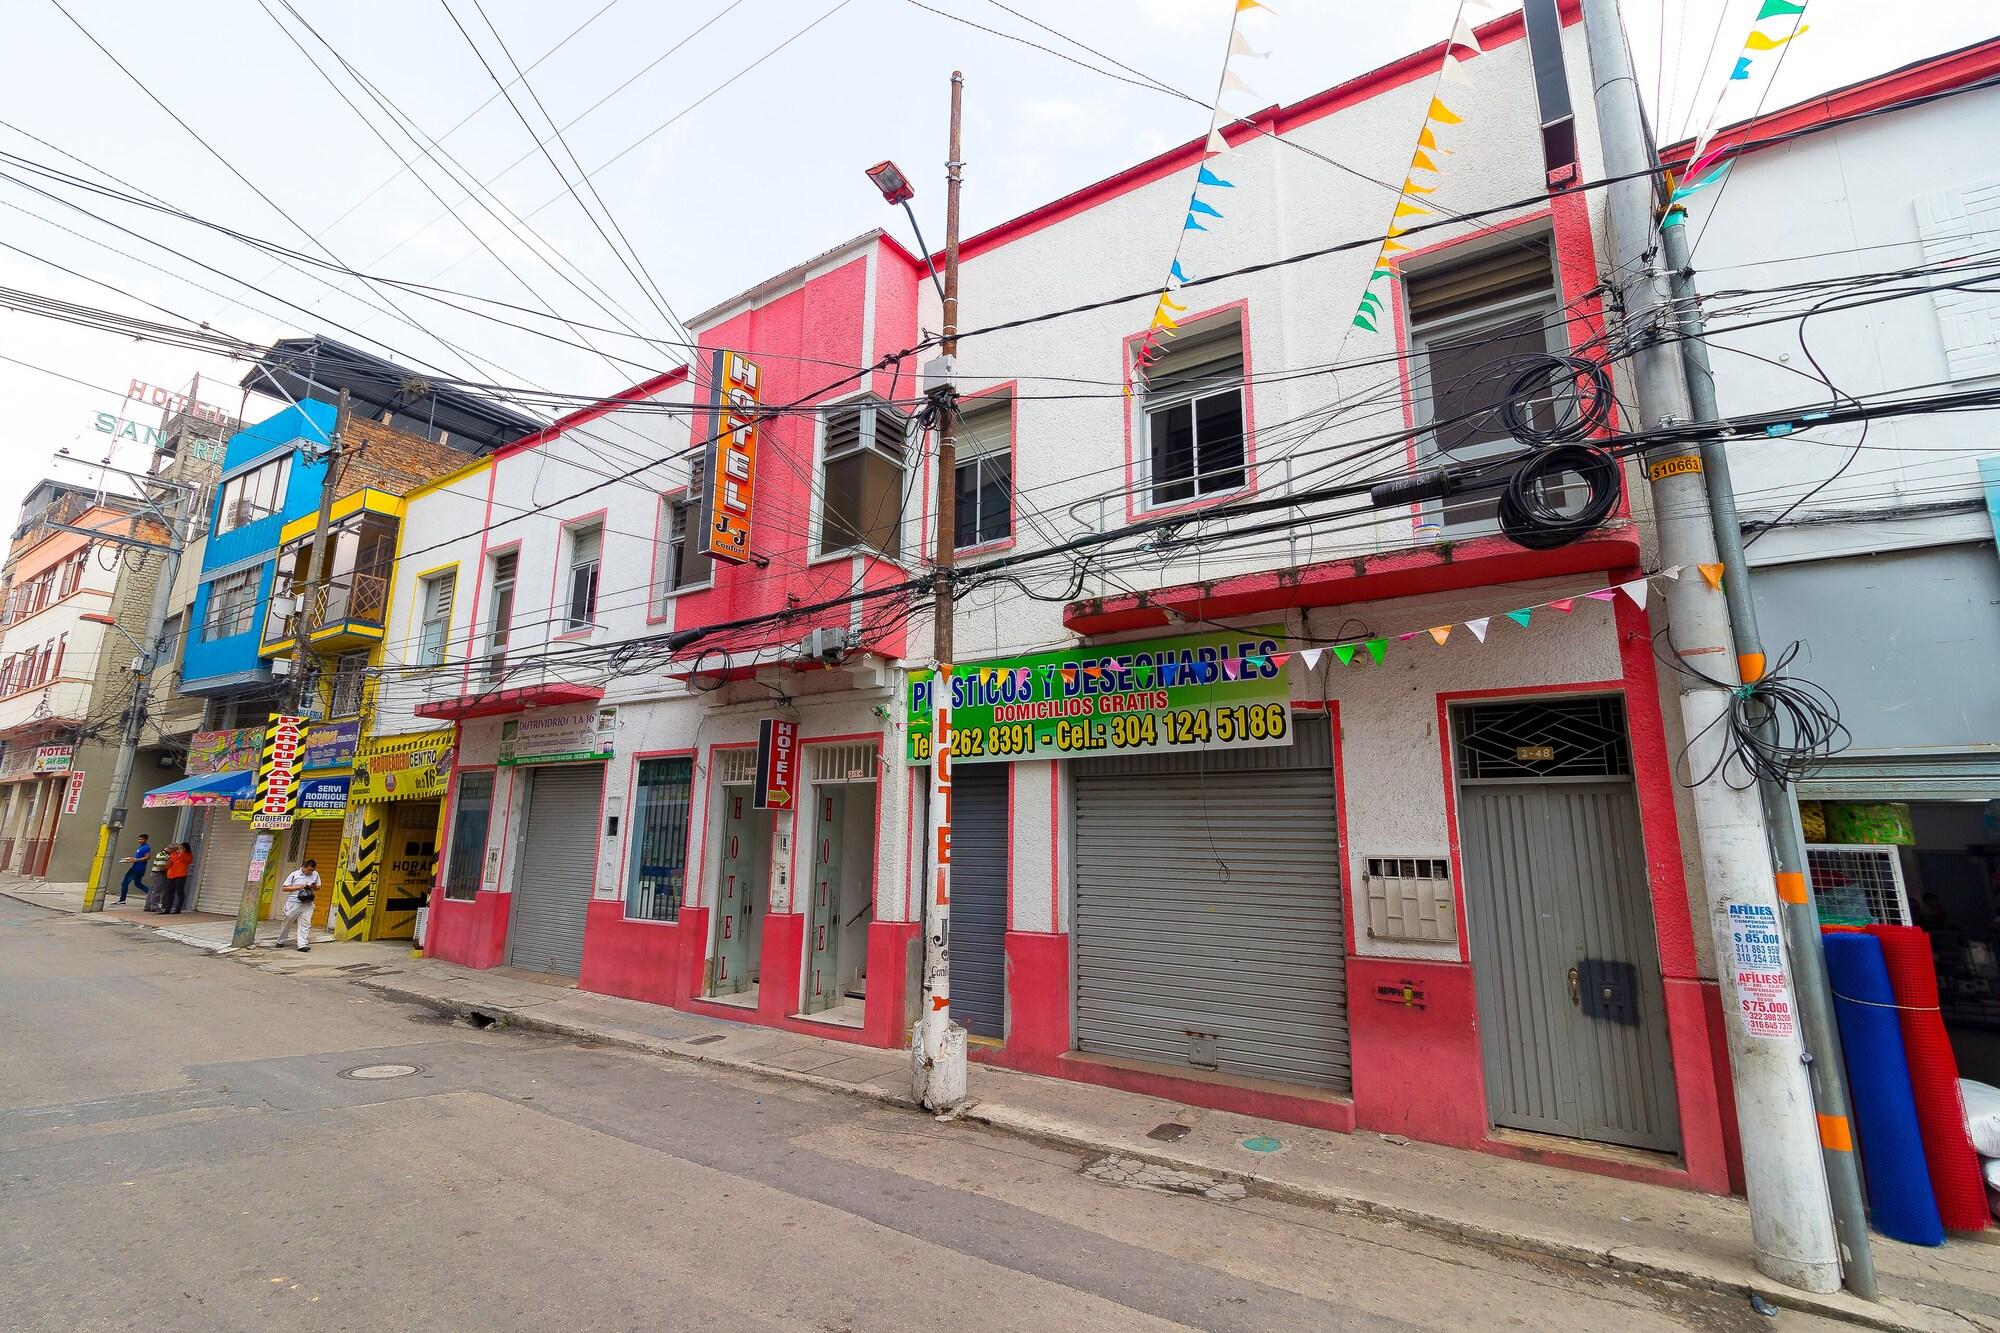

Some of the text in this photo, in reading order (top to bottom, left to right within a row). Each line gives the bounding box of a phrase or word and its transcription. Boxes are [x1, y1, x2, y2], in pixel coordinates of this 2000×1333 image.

[128, 379, 227, 426] HOTEL
[95, 412, 167, 449] SAN
[724, 354, 757, 512] HOTEL
[715, 540, 746, 554] Confort
[1037, 663, 1056, 700] Y
[1062, 639, 1279, 698] DESECHABLES
[993, 689, 1169, 724] DOMICILIOS GRATIS
[988, 723, 1035, 755] 8391
[1056, 718, 1106, 751] Cel.:
[1111, 711, 1157, 748] 304
[1162, 708, 1213, 745] 124
[1216, 702, 1287, 742] 5186
[40, 747, 73, 757] HOTEL
[263, 716, 301, 814] PARQUEADERO
[409, 749, 437, 768] CENTRO
[777, 722, 792, 786] HOTEL
[1520, 748, 1551, 758] 2-48
[67, 772, 84, 813] HOTEL
[317, 785, 342, 793] SERVI
[424, 768, 436, 789] 16
[719, 796, 743, 981] HOTEL
[815, 797, 833, 996] HOTEL
[1734, 932, 1780, 945] $ 85.000
[1735, 943, 1749, 953] 311
[1751, 944, 1766, 954] 863
[1736, 953, 1751, 963] 310
[1753, 953, 1767, 963] 254
[1742, 999, 1788, 1014] $ 75.000
[1749, 1012, 1763, 1020] 322
